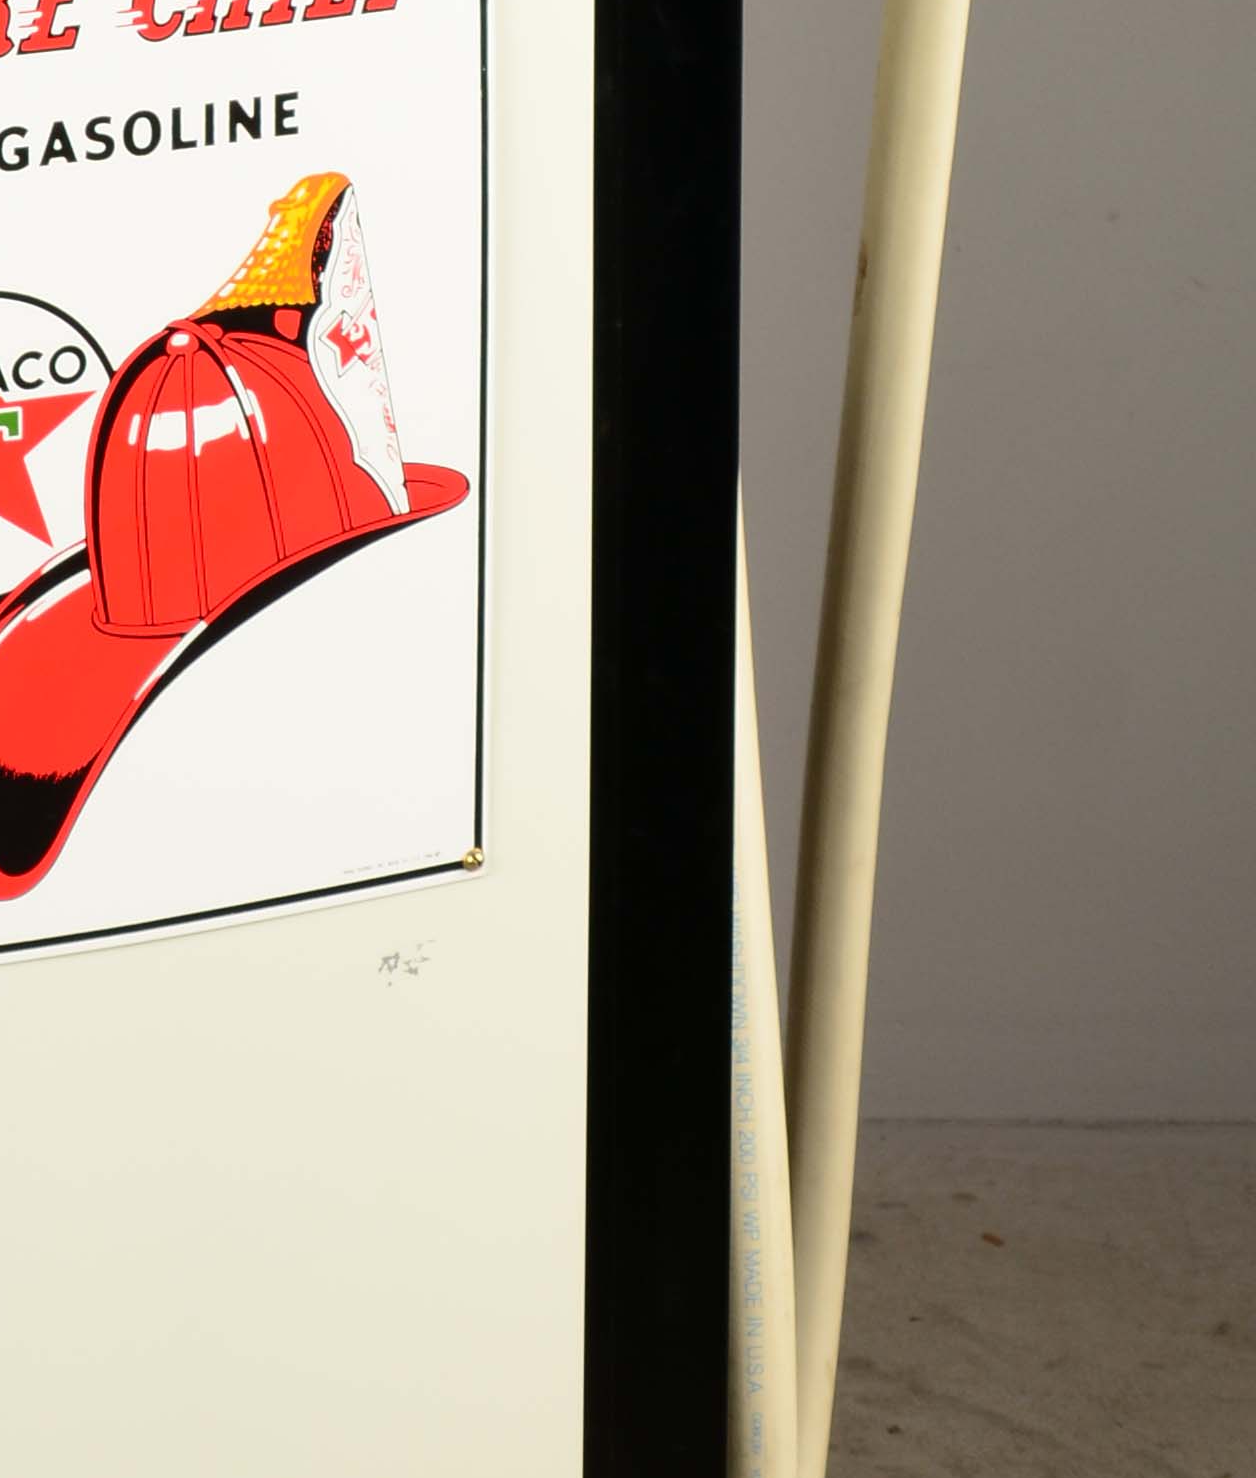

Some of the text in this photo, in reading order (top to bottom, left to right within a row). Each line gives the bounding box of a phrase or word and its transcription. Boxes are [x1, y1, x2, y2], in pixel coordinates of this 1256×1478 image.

[736, 1072, 754, 1124] INCH
[739, 1131, 757, 1165] 200
[740, 1172, 760, 1202] PSI
[744, 1210, 761, 1241] WP
[744, 1248, 763, 1309] MADE
[747, 1316, 764, 1337] IN
